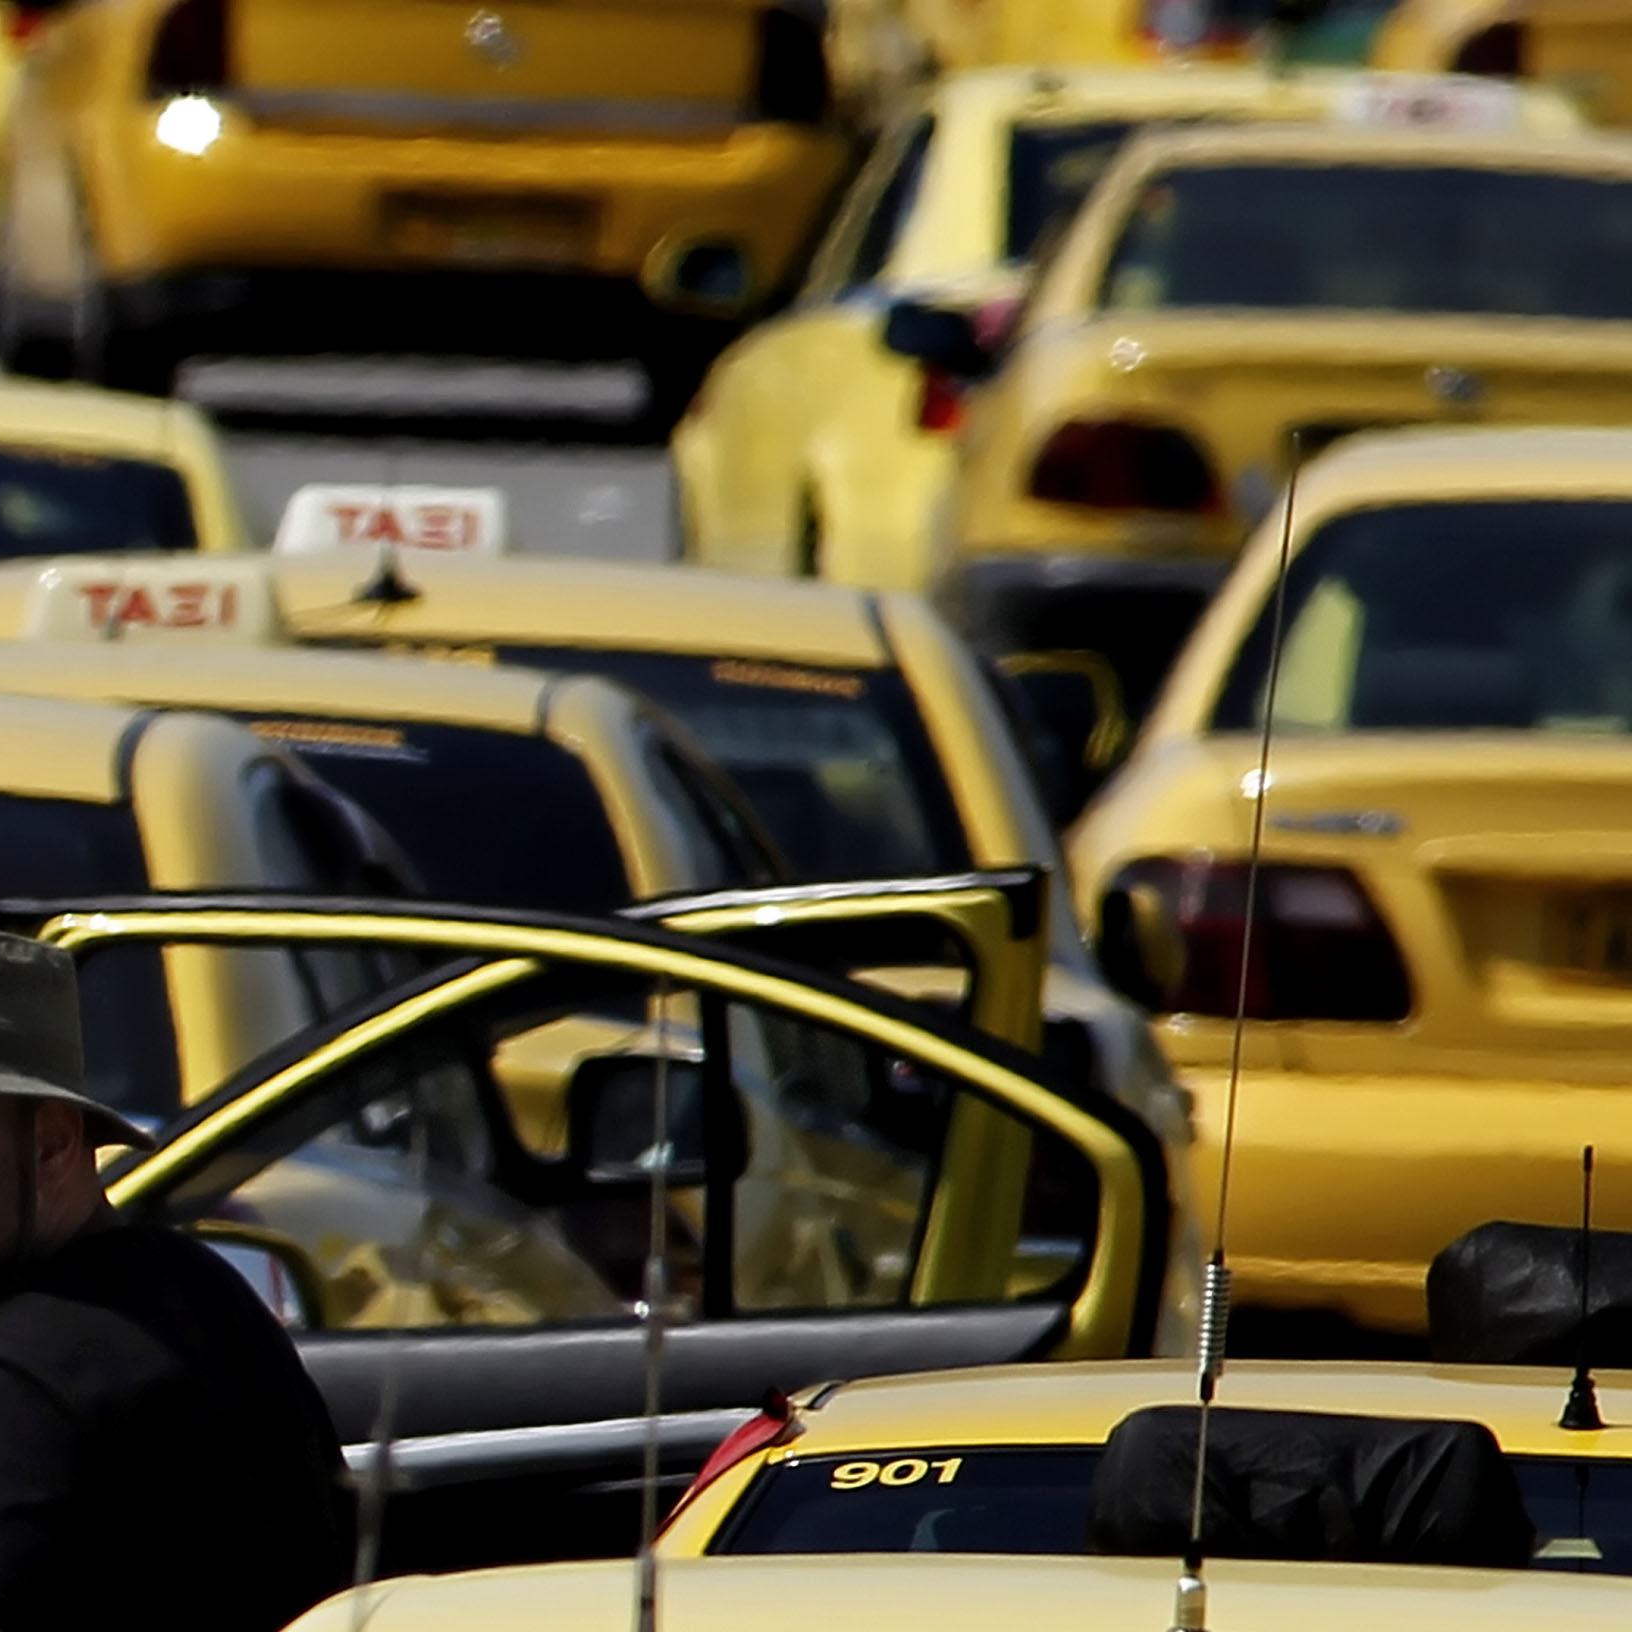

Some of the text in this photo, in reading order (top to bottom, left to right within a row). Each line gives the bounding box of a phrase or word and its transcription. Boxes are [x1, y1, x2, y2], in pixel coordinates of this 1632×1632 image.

[333, 506, 479, 549] ΤΑΞΙ
[83, 583, 239, 628] ΤΑΞΙ
[829, 1456, 962, 1491] 901
